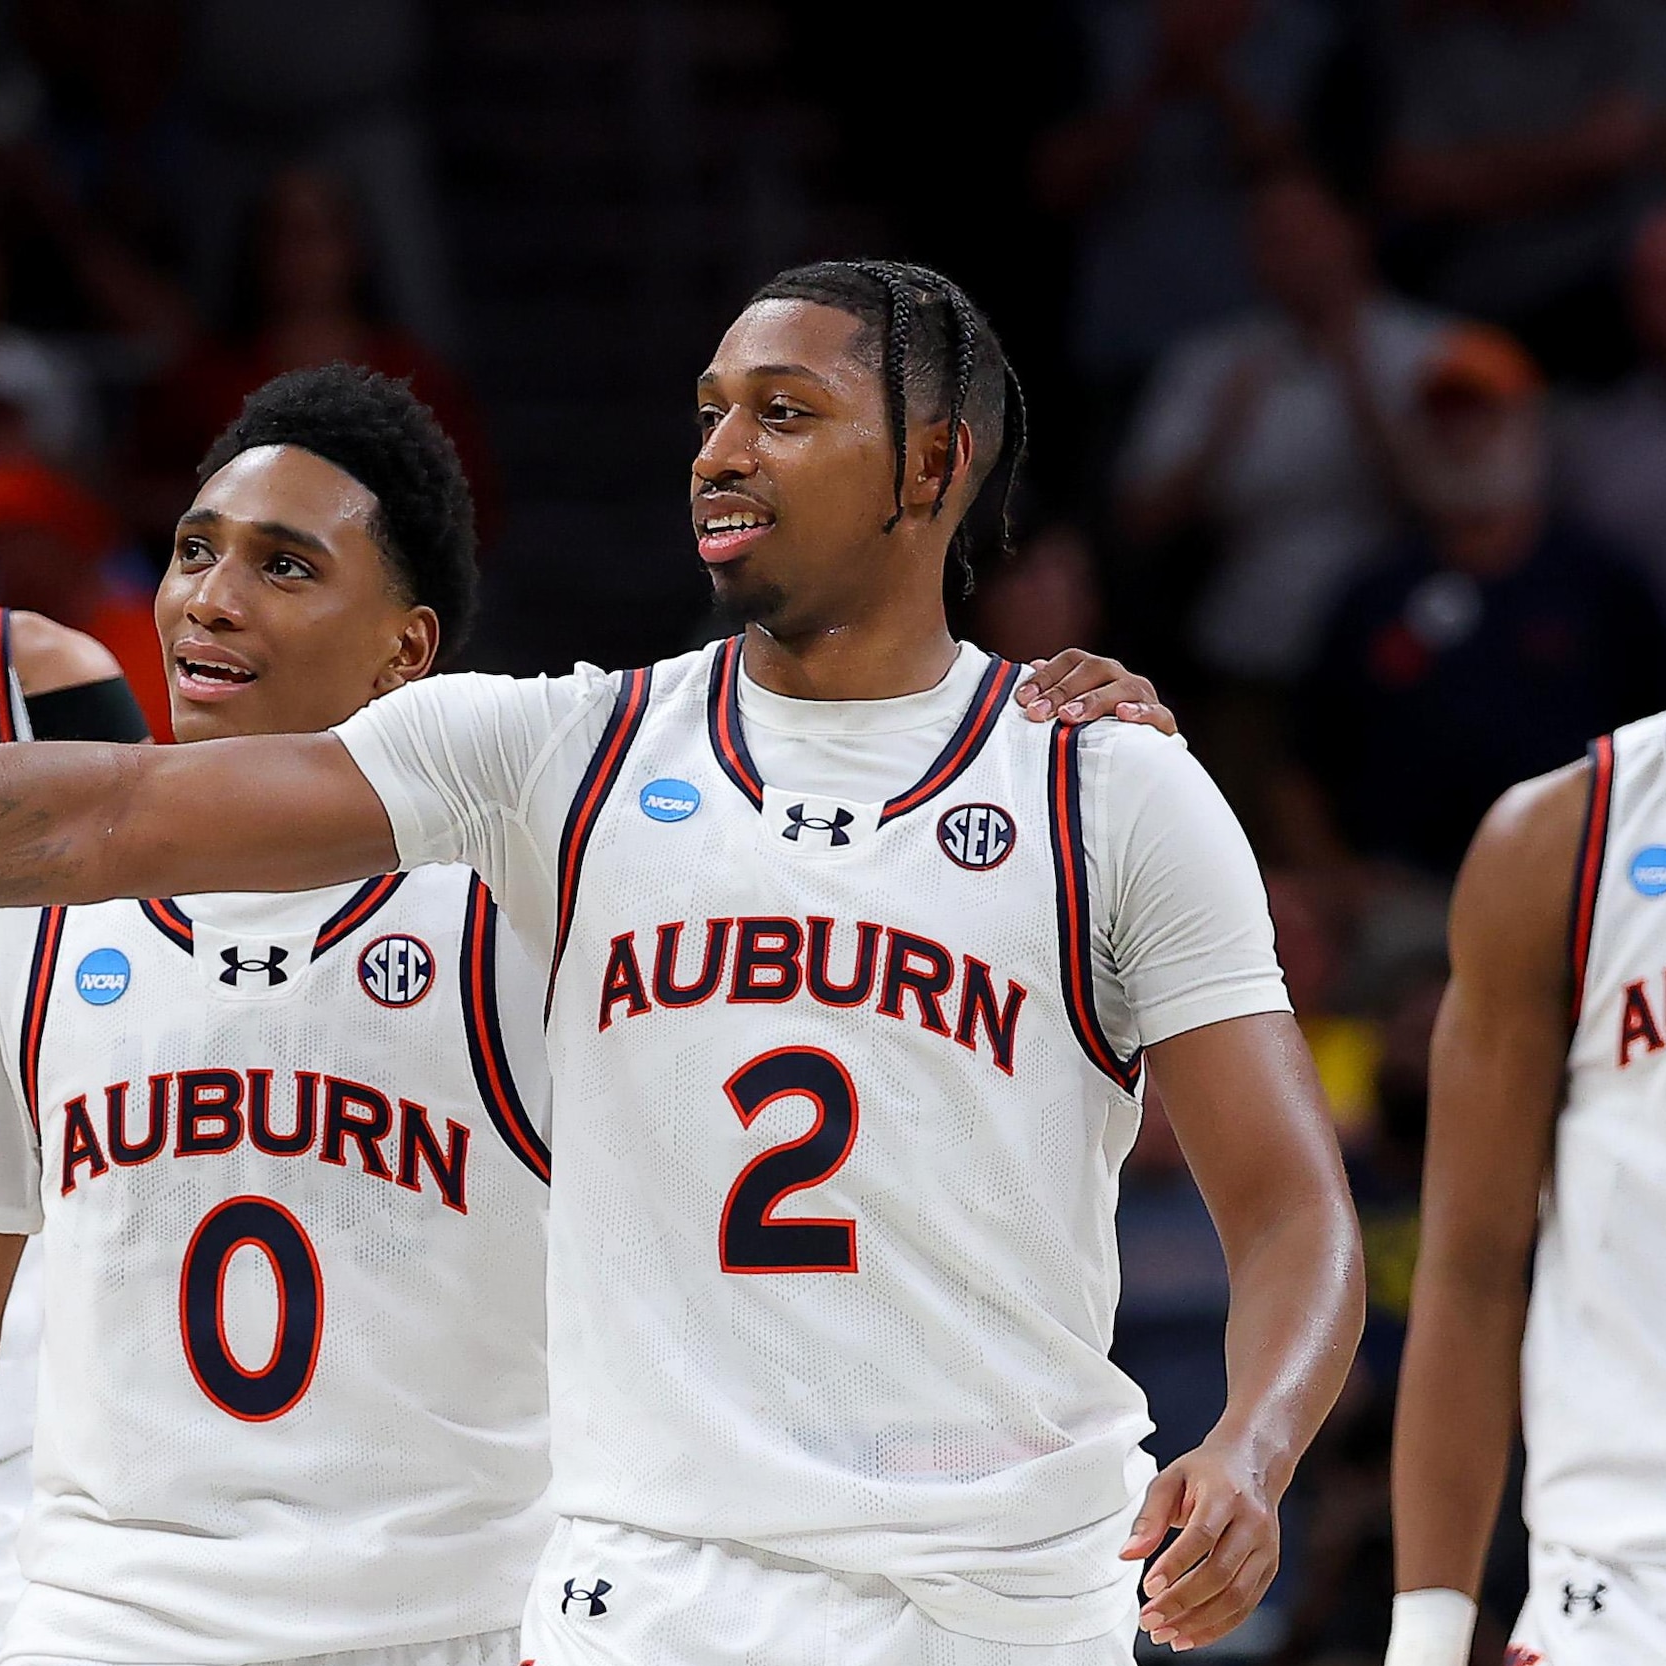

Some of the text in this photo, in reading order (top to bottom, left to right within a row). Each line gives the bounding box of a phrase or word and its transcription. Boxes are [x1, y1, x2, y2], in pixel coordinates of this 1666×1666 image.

[645, 793, 695, 814] NCAA
[943, 806, 1009, 866] SEC
[80, 972, 127, 992] NCAA
[363, 939, 429, 1002] SEC
[598, 916, 1027, 1076] AUBURN
[61, 1068, 471, 1215] AUBURN
[718, 1045, 860, 1274] 2
[179, 1195, 324, 1423] 0
